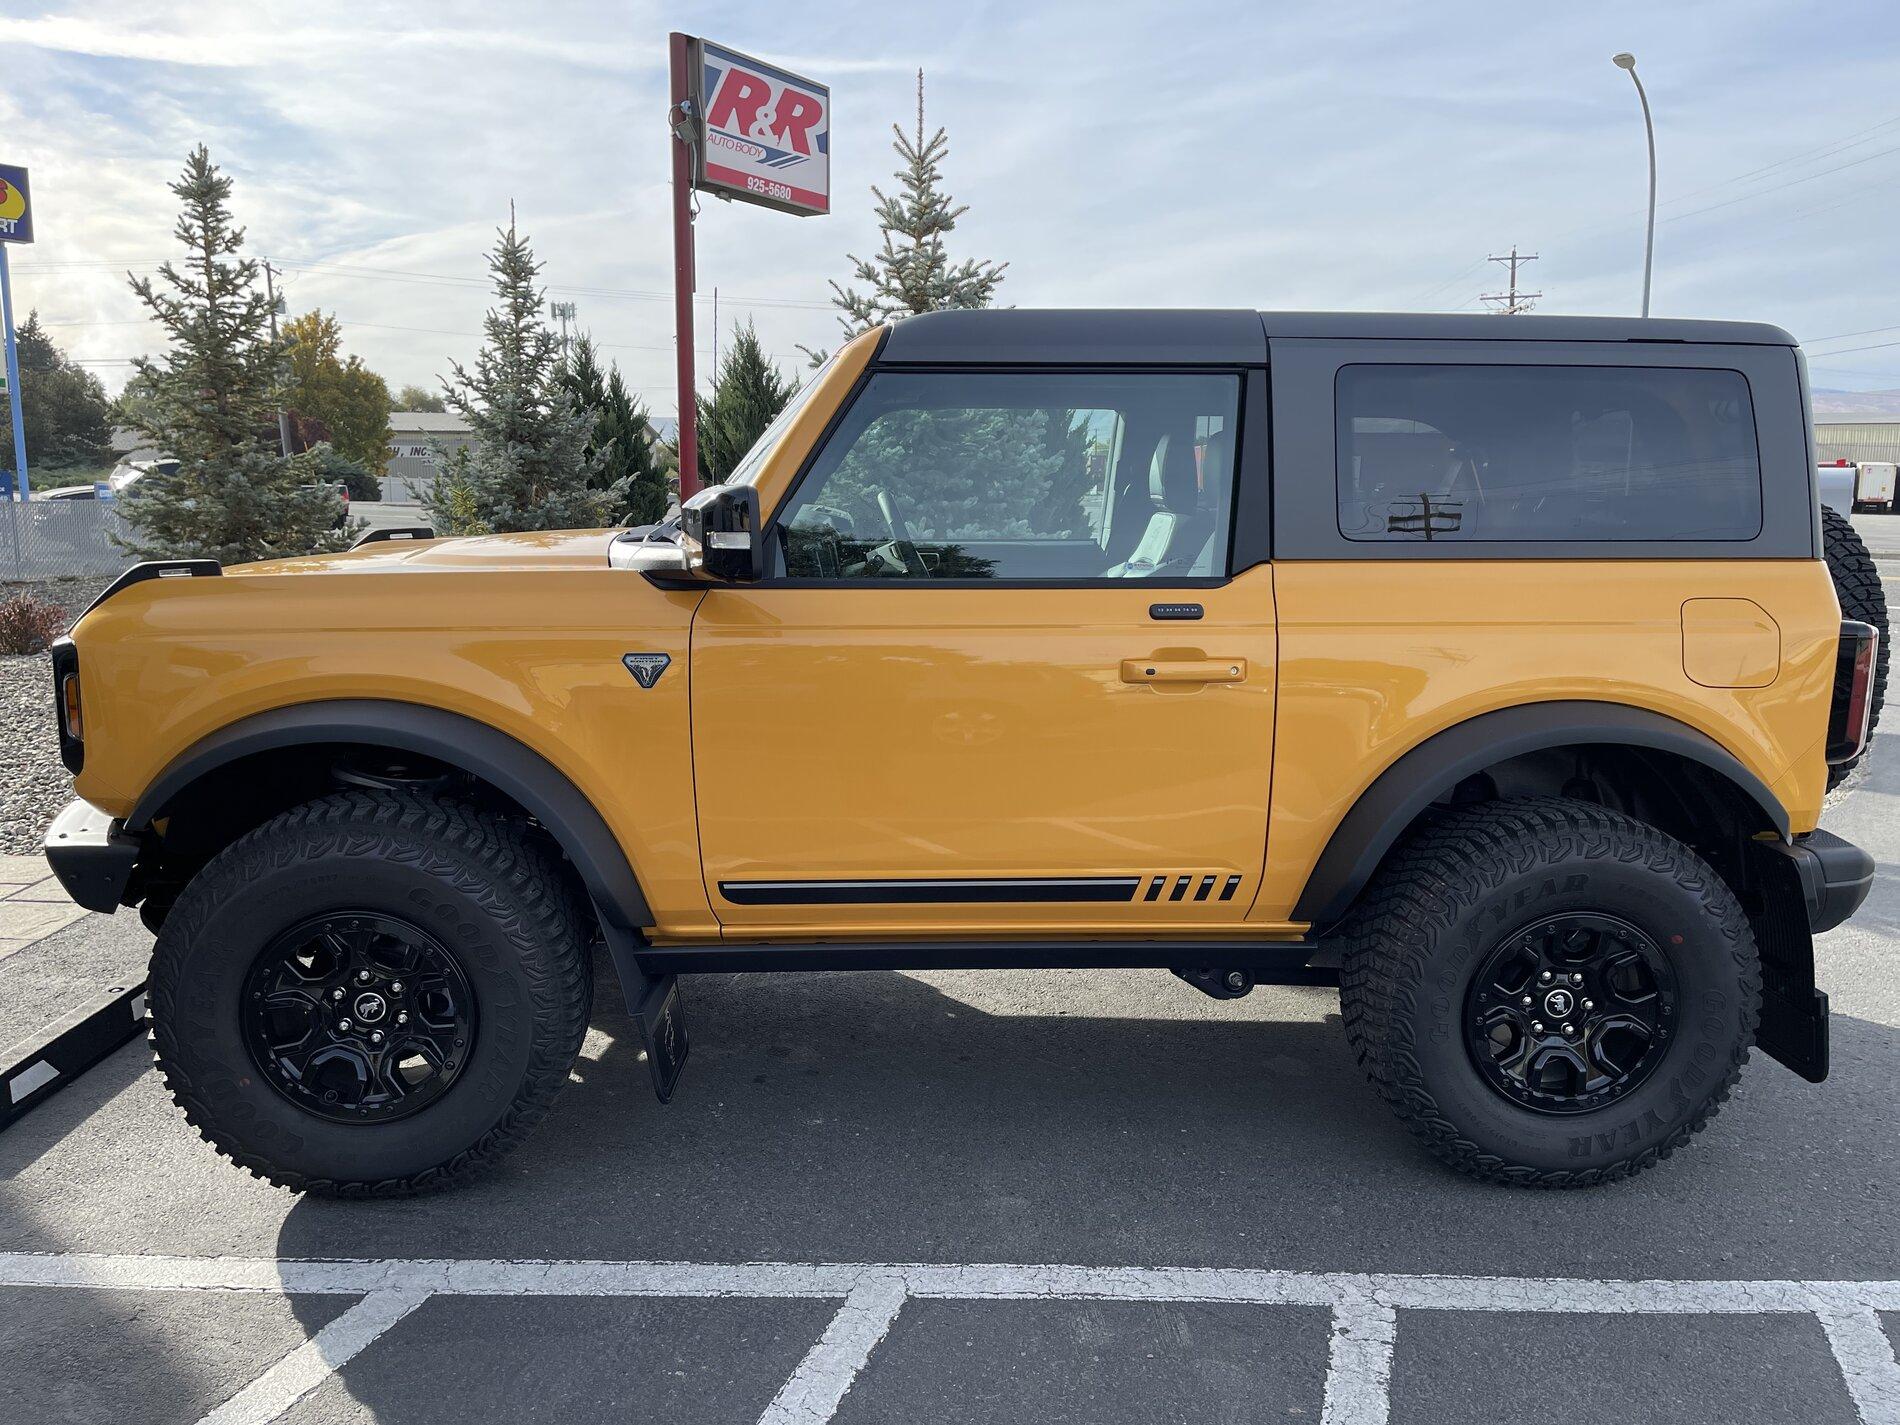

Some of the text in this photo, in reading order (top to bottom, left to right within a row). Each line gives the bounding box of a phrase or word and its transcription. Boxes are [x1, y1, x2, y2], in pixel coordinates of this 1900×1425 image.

[707, 68, 823, 156] R&R
[707, 133, 763, 157] AUTO BODY
[747, 176, 791, 199] 925-5680
[410, 446, 431, 457] INC.
